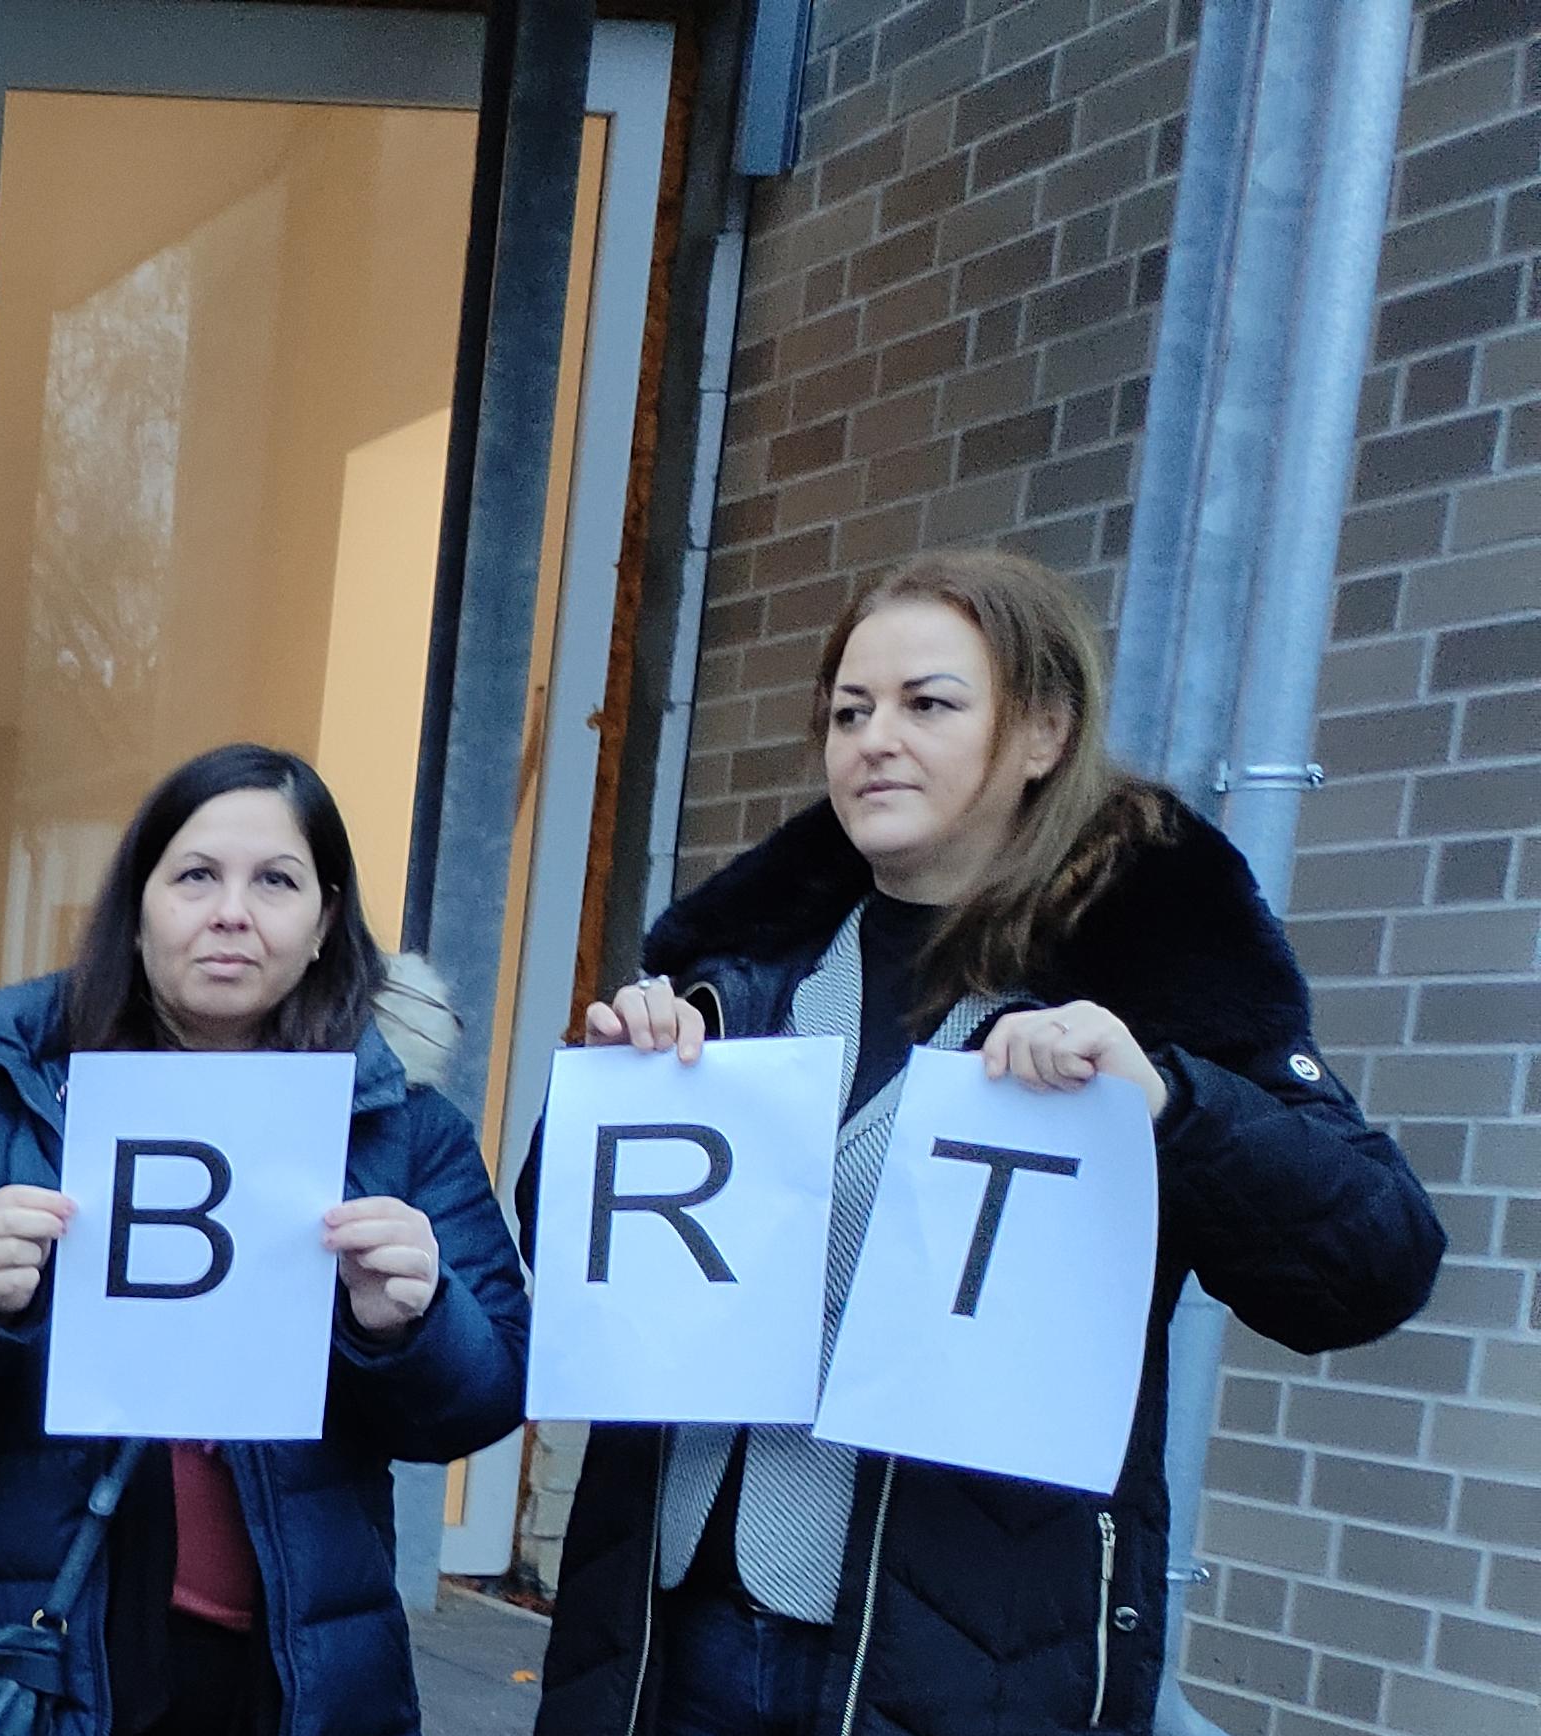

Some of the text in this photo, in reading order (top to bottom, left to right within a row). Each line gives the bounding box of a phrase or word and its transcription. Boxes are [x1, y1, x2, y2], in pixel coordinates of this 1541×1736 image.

[105, 1138, 235, 1300] B
[587, 1123, 738, 1283] R
[929, 1136, 1082, 1318] T
